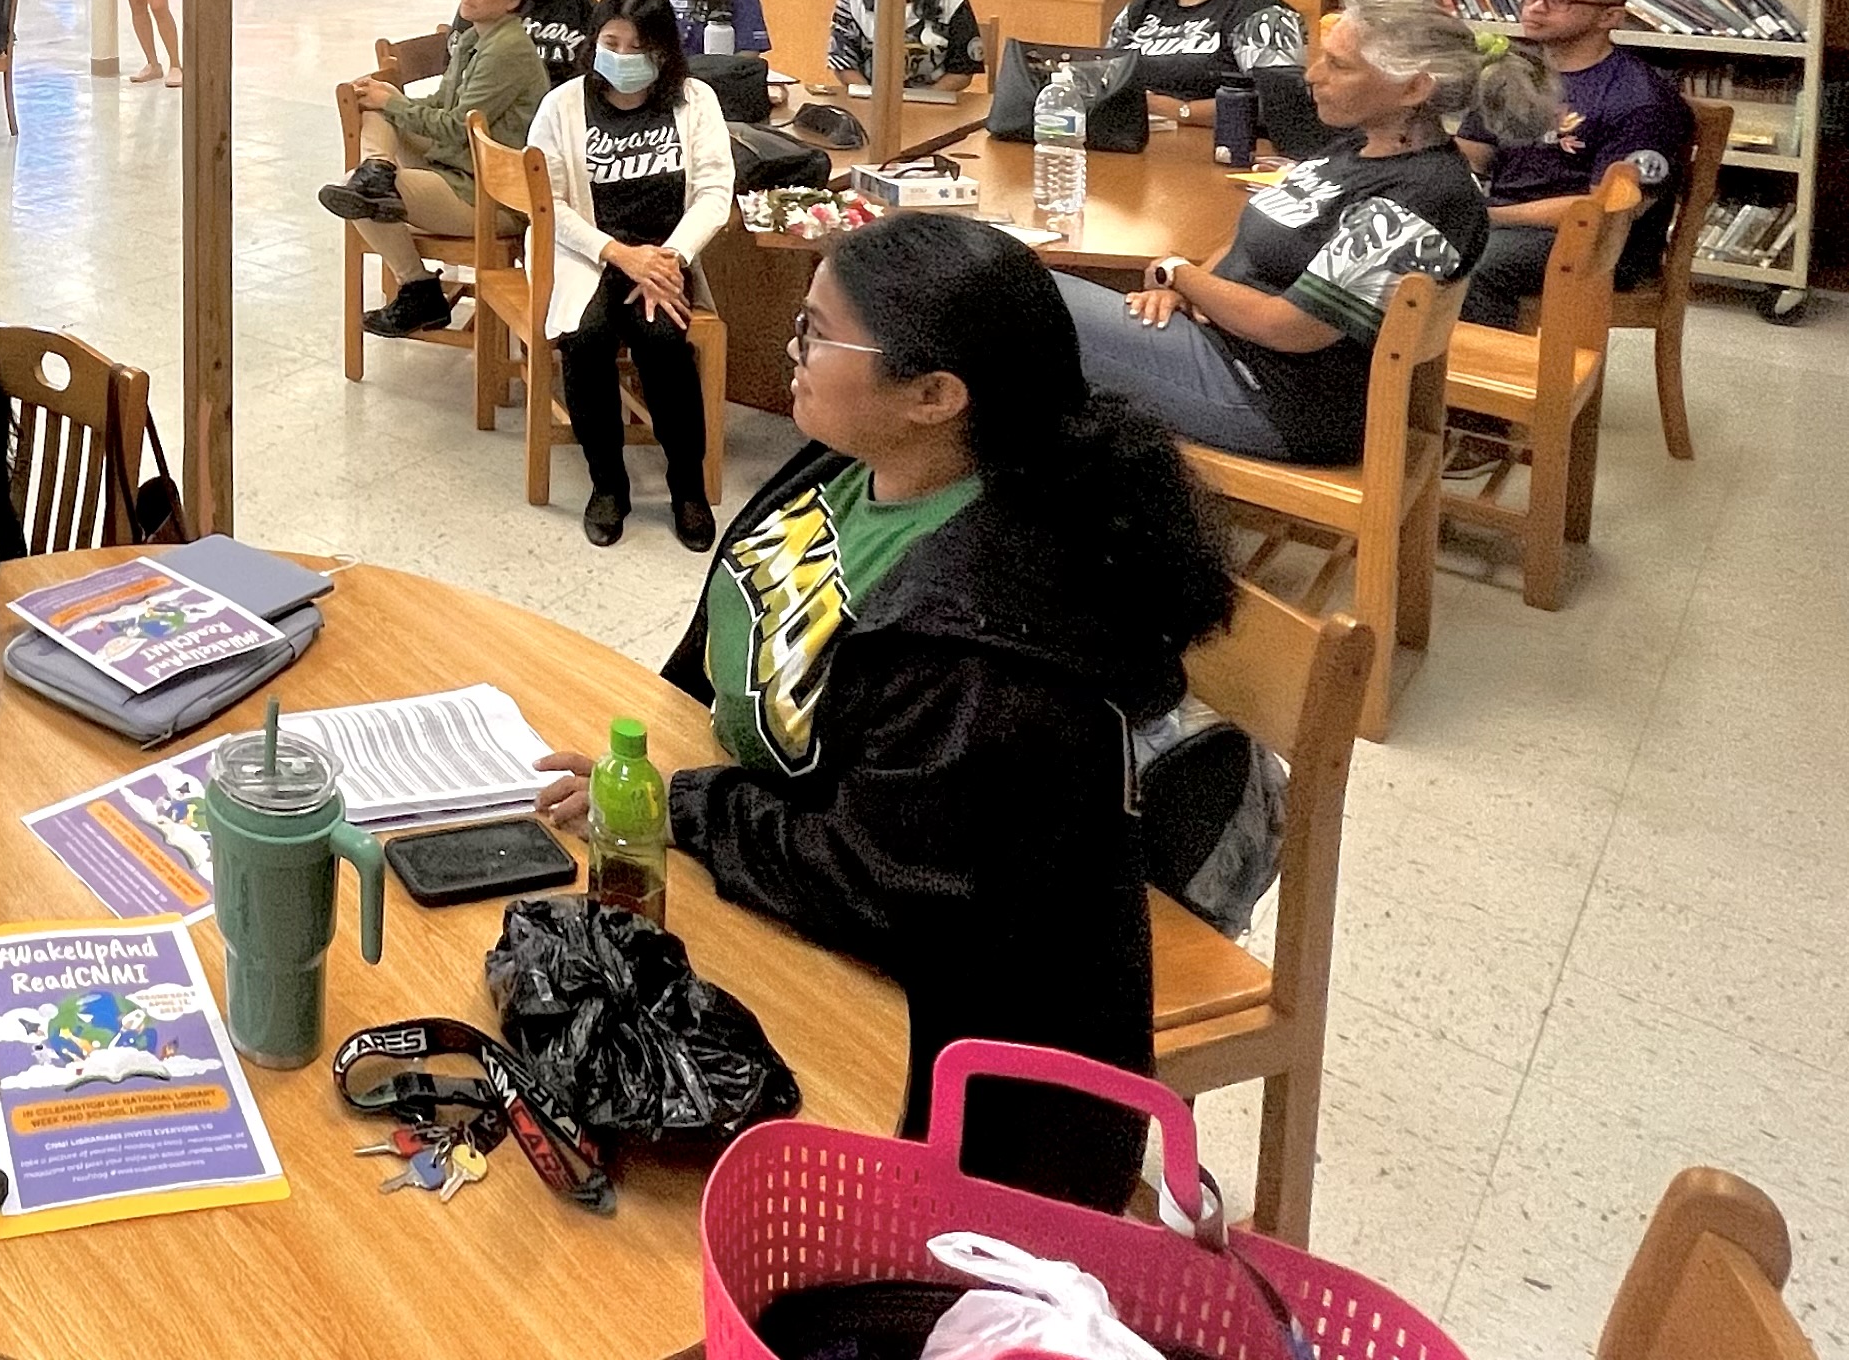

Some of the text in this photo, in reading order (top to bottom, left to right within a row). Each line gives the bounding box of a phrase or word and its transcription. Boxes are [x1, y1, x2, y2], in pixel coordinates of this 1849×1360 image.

[11, 963, 149, 994] ReadCNMI
[335, 1027, 427, 1073] CARES
[31, 1100, 211, 1128] WEEK AND SCHOOL LIBRARY MONTH
[35, 1101, 105, 1116] CELEBRATION
[122, 1094, 172, 1105] NATIONAL
[174, 1089, 216, 1099] LIBRARY
